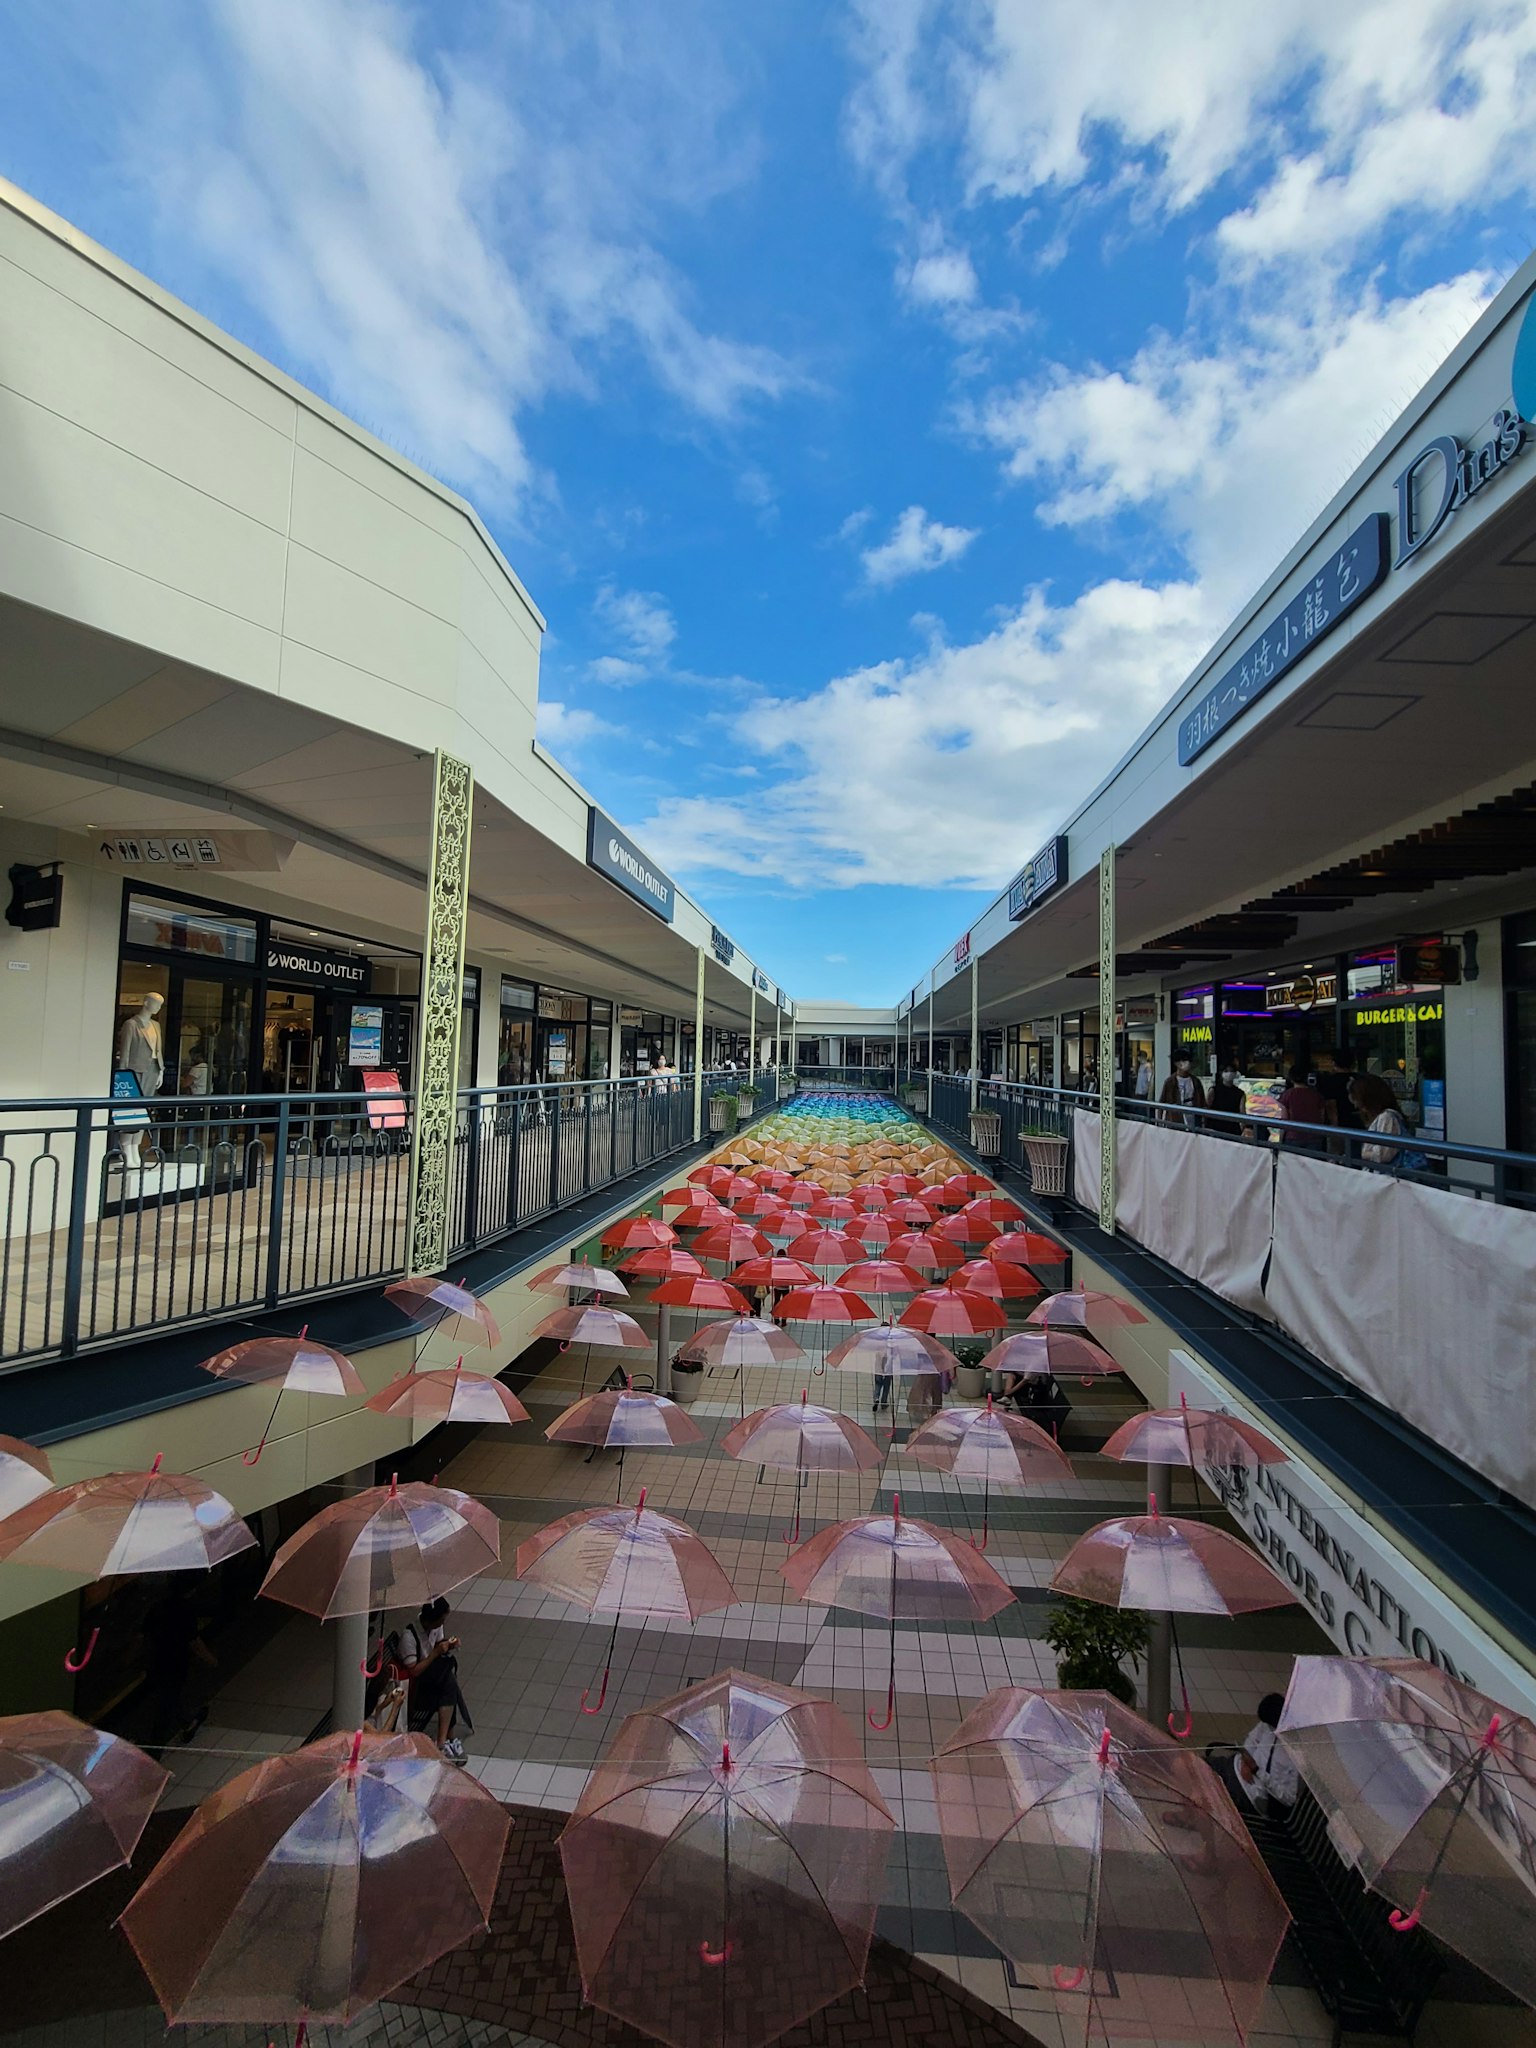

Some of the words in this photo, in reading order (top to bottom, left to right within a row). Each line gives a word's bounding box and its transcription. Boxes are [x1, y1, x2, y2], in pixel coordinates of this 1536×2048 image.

[1393, 410, 1527, 571] Din's
[618, 846, 645, 884] WORLD
[645, 871, 669, 904] OUTLET
[279, 954, 322, 974] WORLD
[324, 963, 365, 981] OUTLET
[1356, 1007, 1406, 1026] BURGER
[1407, 1007, 1417, 1023] &
[1253, 1501, 1336, 1628] SHOES
